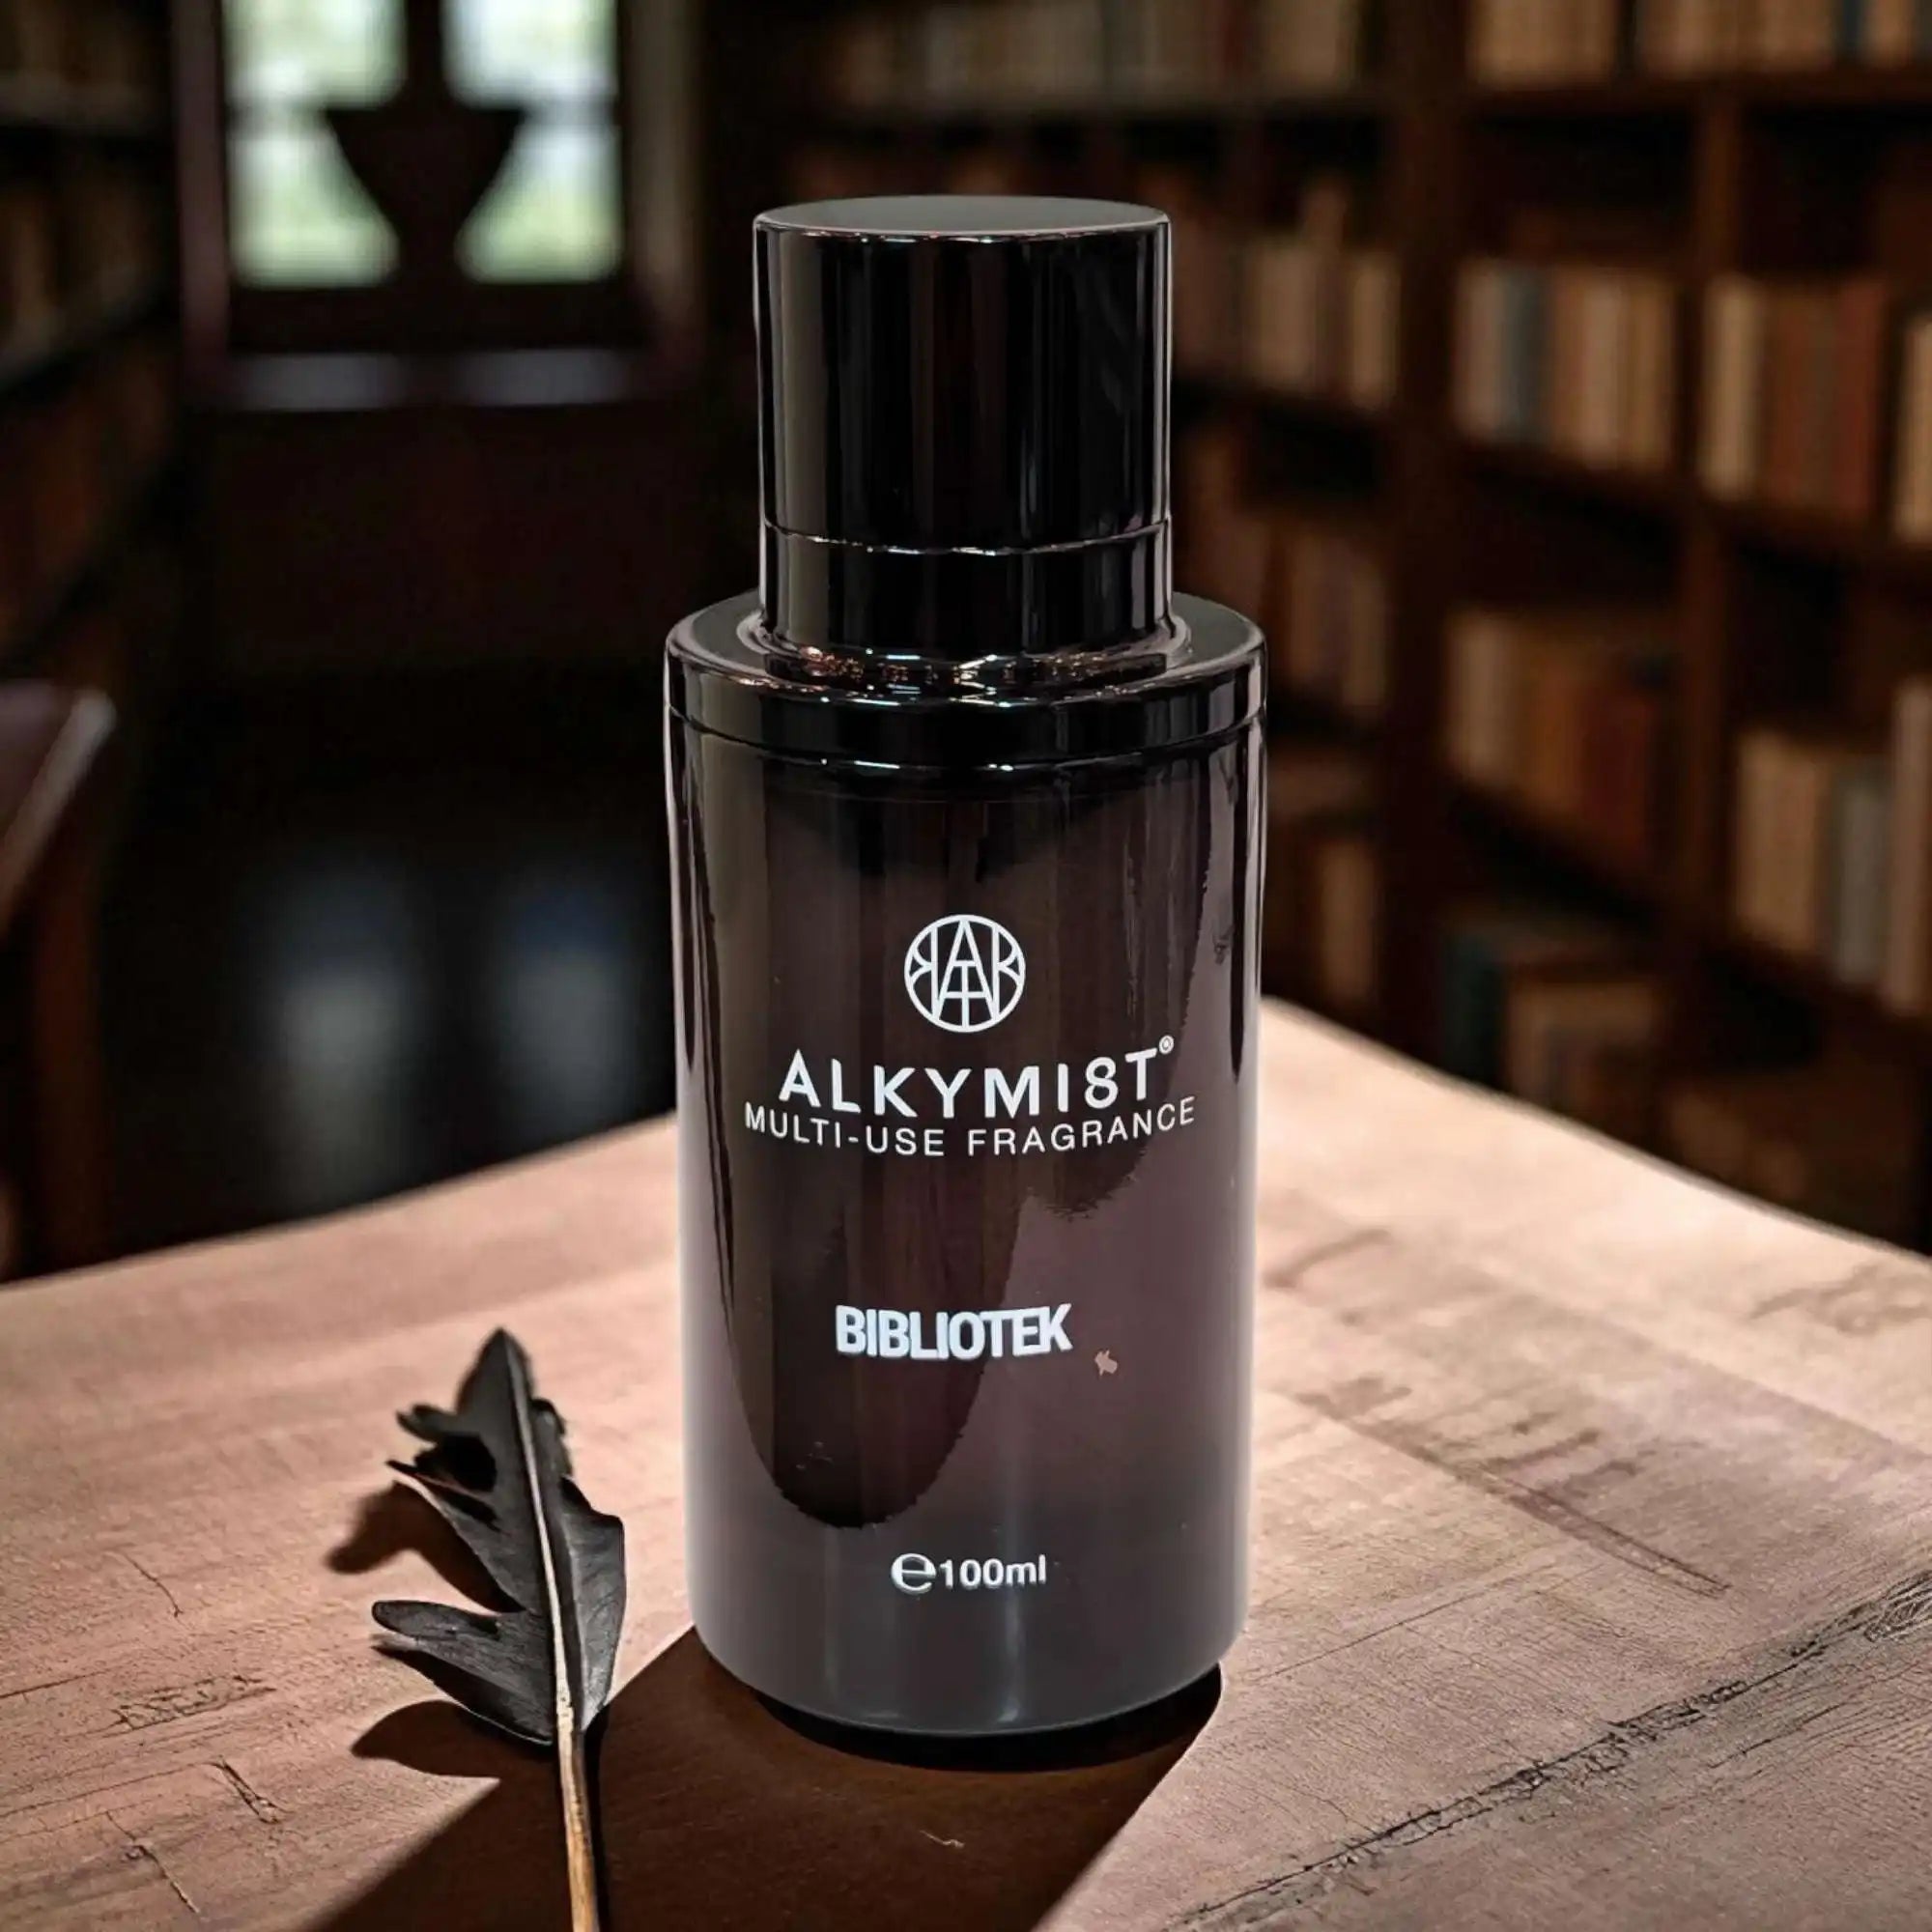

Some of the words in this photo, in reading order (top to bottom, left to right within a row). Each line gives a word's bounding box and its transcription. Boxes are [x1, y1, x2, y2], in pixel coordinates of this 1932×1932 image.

[744, 1101, 946, 1157] MULTI-USE
[968, 1095, 1196, 1156] FRAGRANCE
[835, 1302, 1074, 1360] BIBLIOTEK
